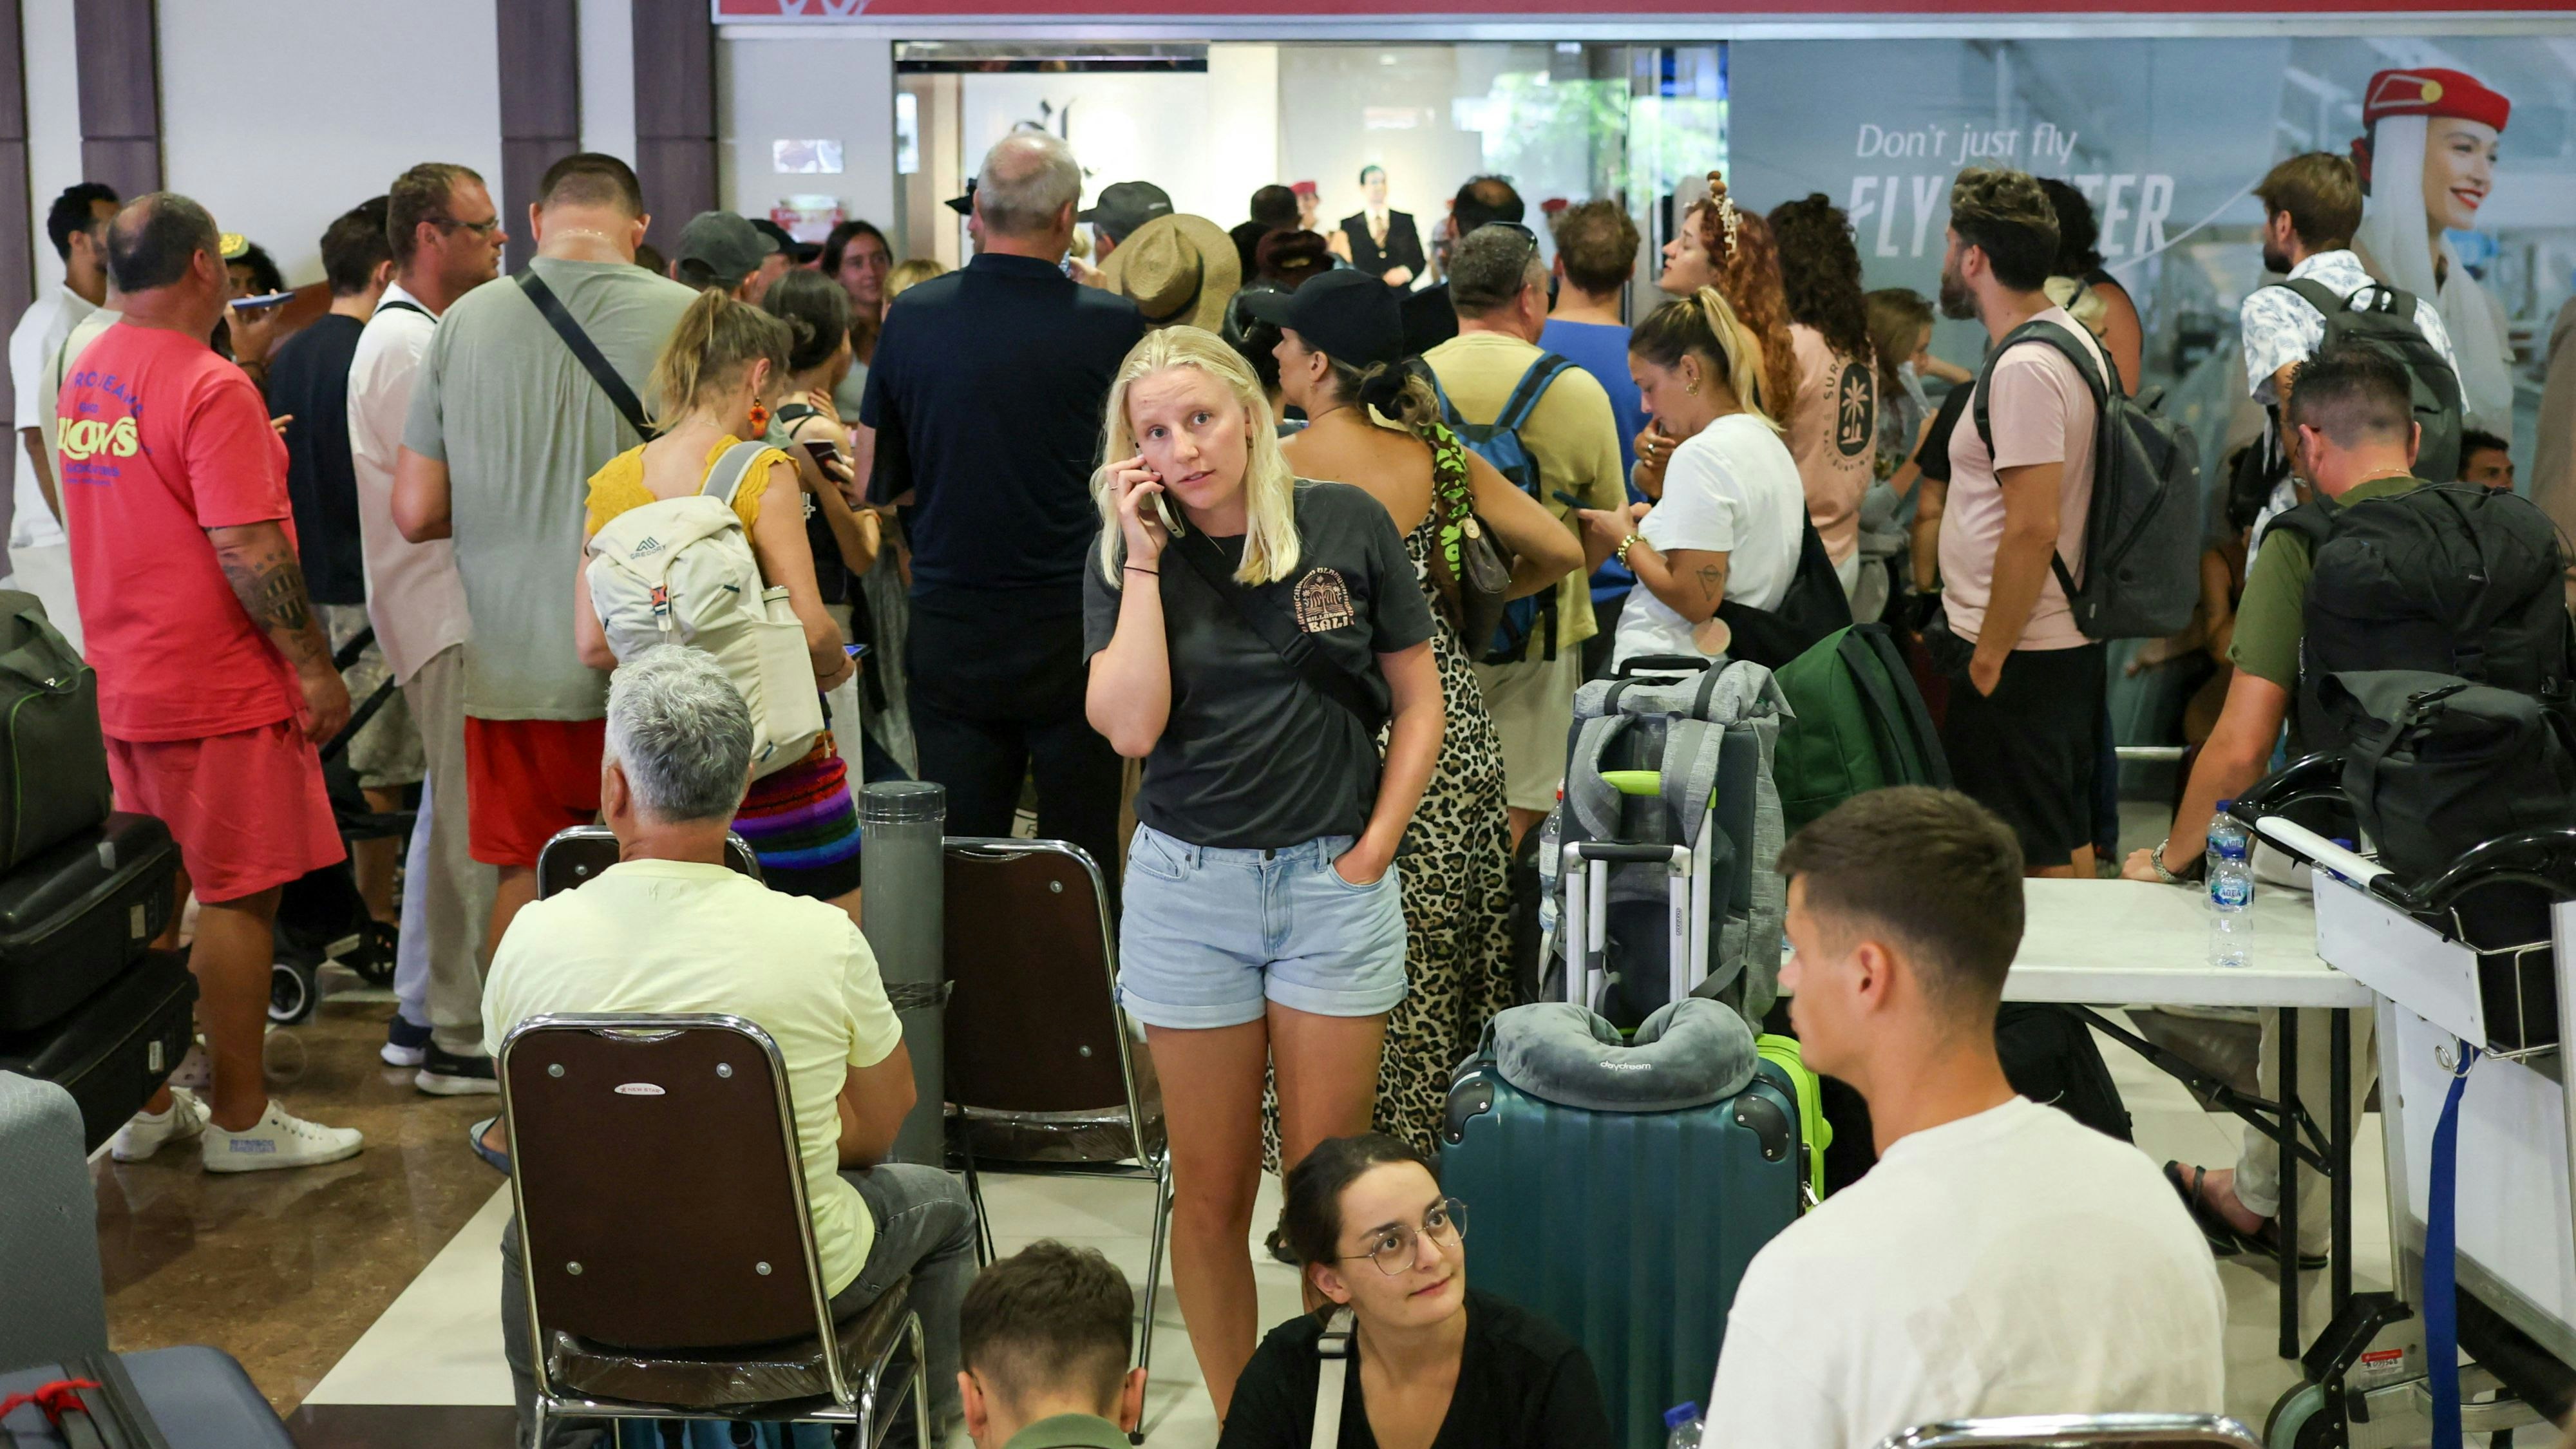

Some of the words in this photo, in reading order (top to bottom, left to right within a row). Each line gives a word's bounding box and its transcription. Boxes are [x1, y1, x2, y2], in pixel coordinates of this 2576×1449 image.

[1857, 124, 1946, 158] Don't
[1951, 124, 2020, 166] just
[2031, 122, 2078, 164] fly
[1848, 175, 1943, 257] FLY
[2061, 174, 2175, 256] TER
[630, 544, 666, 560] GREGORY
[1308, 616, 1349, 633] BALI
[2221, 889, 2241, 897] AQUA
[1600, 1060, 1651, 1072] daydream
